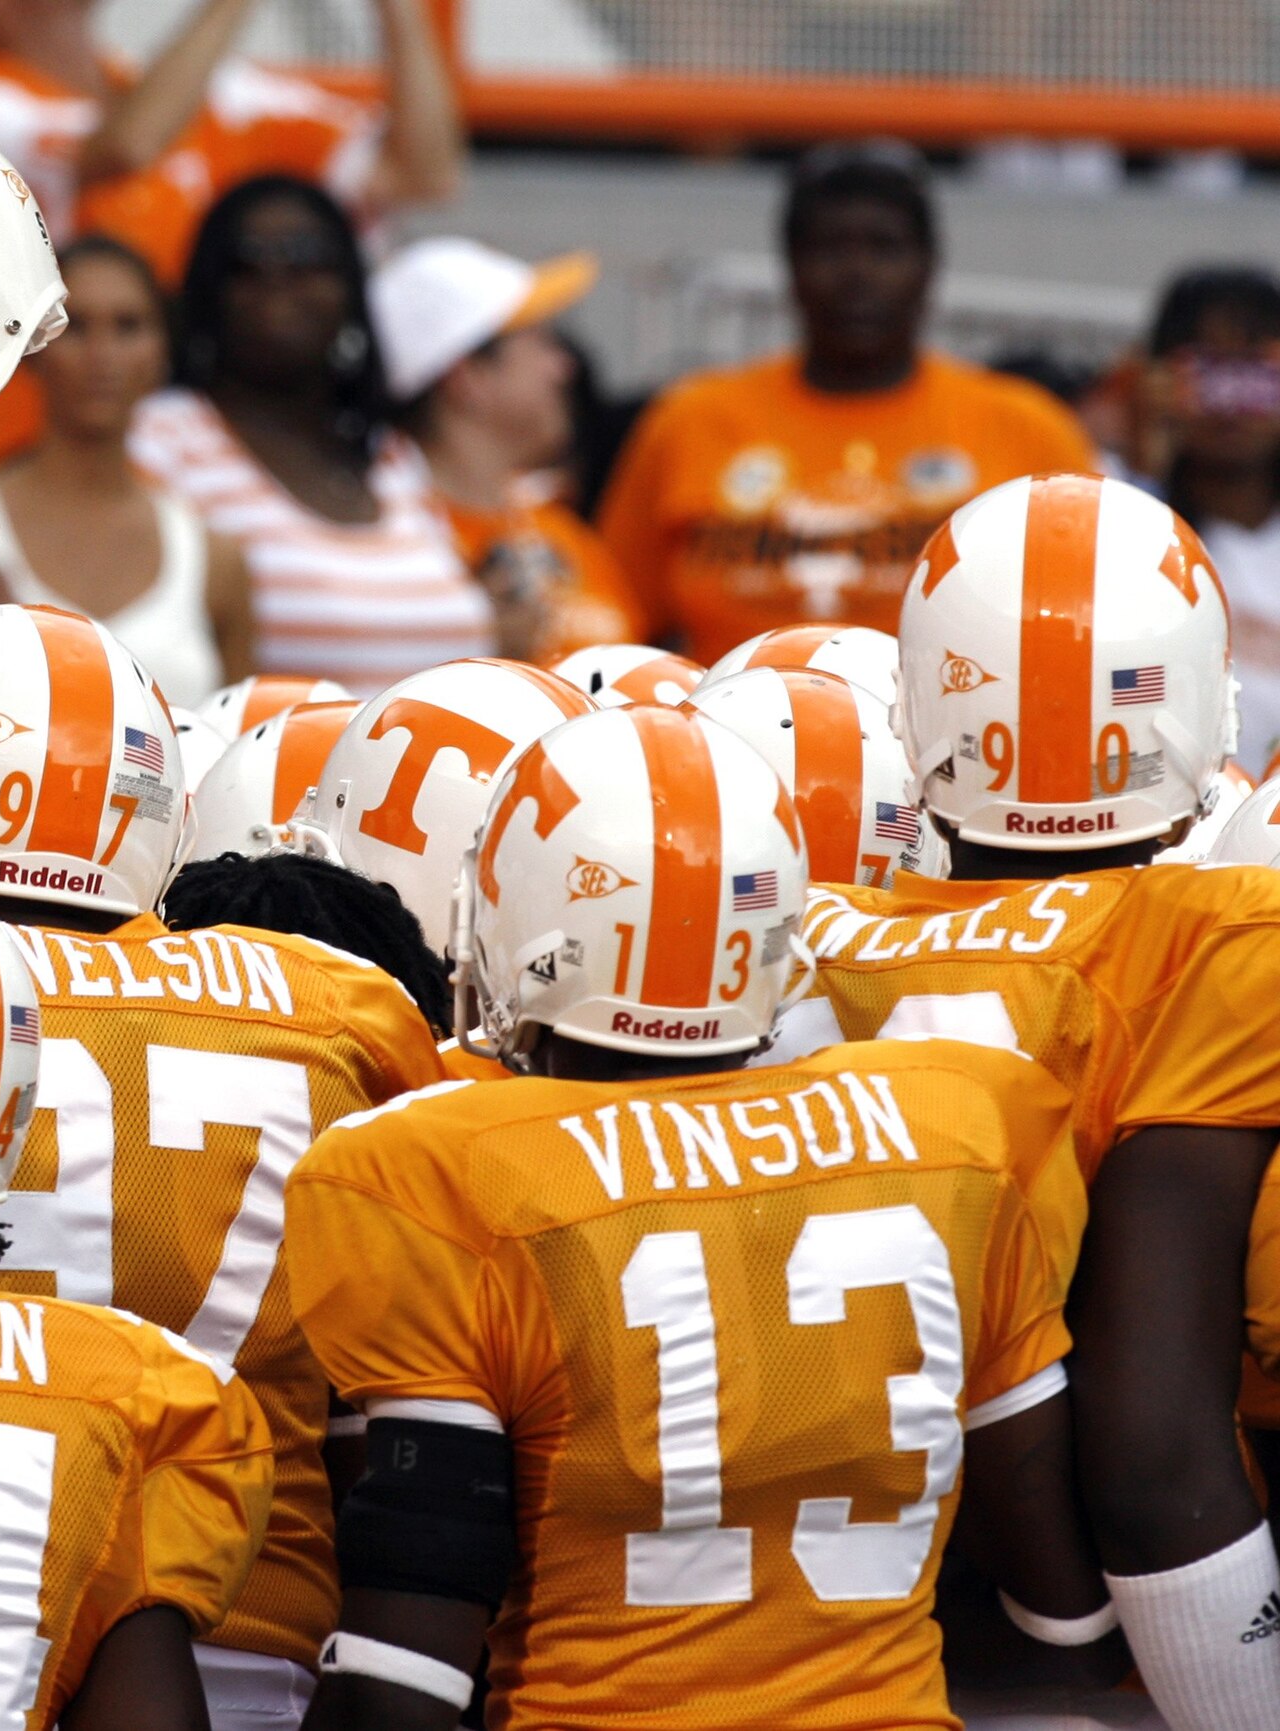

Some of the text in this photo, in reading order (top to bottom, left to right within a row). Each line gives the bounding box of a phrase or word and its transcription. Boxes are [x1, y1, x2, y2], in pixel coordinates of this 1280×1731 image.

[359, 697, 516, 856] T
[1006, 811, 1115, 835] Riddell
[580, 865, 608, 896] SEC
[3, 922, 295, 1017] NELSON
[611, 1011, 720, 1041] Riddell
[558, 1072, 919, 1200] VINSON
[621, 1204, 964, 1606] 13
